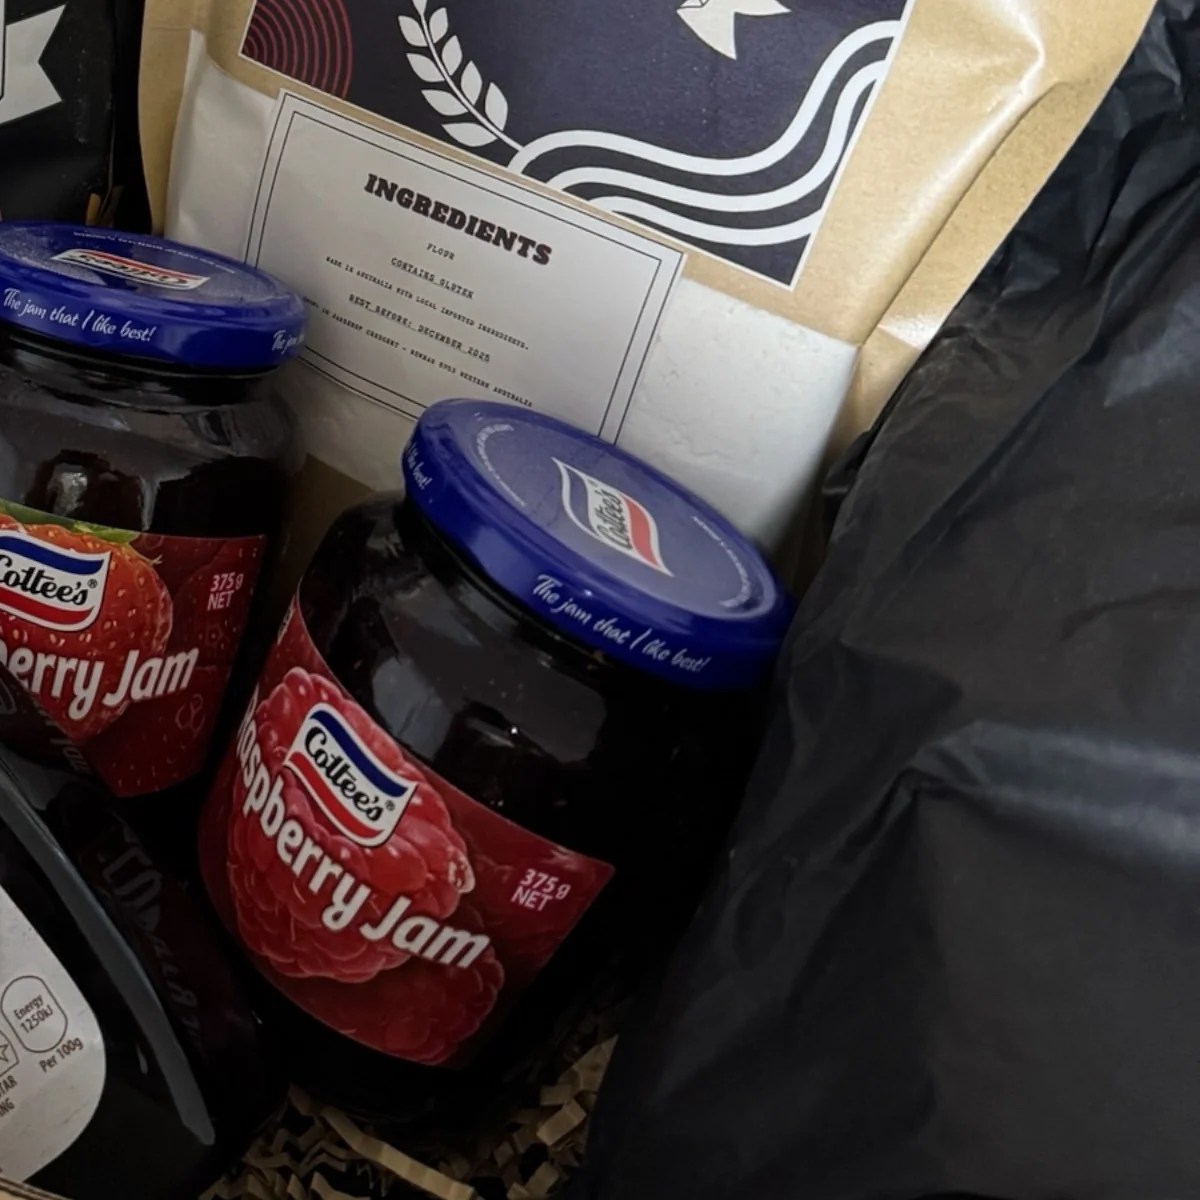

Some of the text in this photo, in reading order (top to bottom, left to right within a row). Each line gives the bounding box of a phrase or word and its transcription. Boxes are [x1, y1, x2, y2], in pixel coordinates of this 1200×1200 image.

[363, 173, 553, 266] INGREDIENTS
[426, 243, 455, 261] FLOUR
[391, 257, 475, 300] CONTAINS GLUTEN
[3, 287, 157, 342] The jam that I like best!
[348, 293, 371, 311] BEST
[417, 325, 463, 350] DECEMBER
[467, 346, 491, 363] 2025
[415, 296, 438, 311] LOCAL
[207, 590, 235, 611] NET
[532, 573, 713, 674] The jam that I like best!
[102, 648, 200, 707] Jam
[305, 725, 385, 823] Cottee's
[510, 887, 553, 913] NET
[359, 895, 491, 969] Jam
[13, 994, 44, 1020] Energy
[39, 1036, 85, 1073] Per 100g
